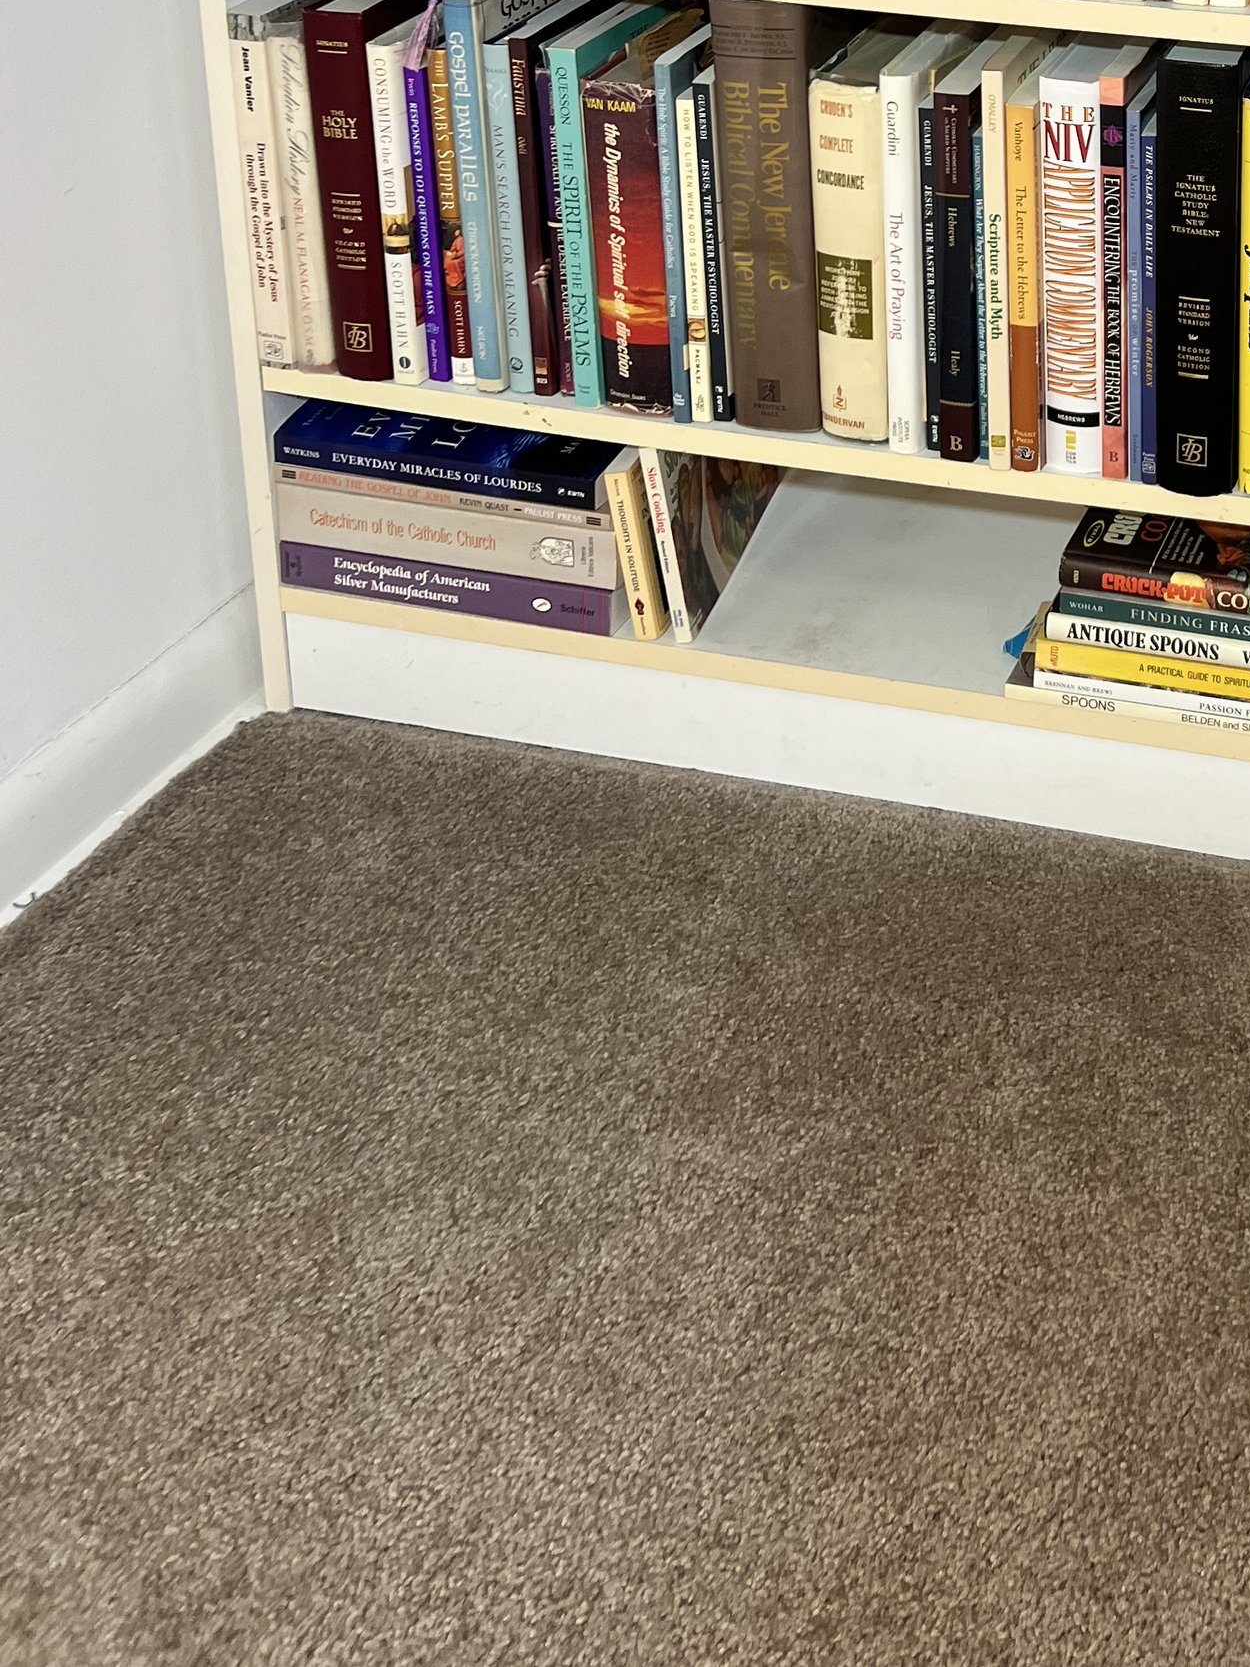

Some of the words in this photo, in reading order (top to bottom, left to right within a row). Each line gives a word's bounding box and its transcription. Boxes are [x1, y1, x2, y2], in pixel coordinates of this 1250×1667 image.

[555, 66, 571, 126] QUESSON
[586, 98, 604, 111] VAN
[607, 99, 636, 113] KAAM
[1178, 96, 1214, 105] IGNATIUS
[431, 83, 454, 142] LAMB'S
[757, 81, 789, 134] The
[820, 99, 853, 118] CRUDEN'S
[1042, 102, 1095, 122] THE
[321, 115, 357, 129] HOLY
[723, 80, 754, 177] Biblical
[886, 100, 900, 156] Guardini
[323, 127, 358, 140] BIBLE
[923, 120, 933, 167] GUARENDI
[1043, 119, 1096, 163] NIV
[819, 135, 854, 154] COMPLETE
[438, 150, 456, 211] SUPPER
[760, 140, 789, 200] New
[817, 169, 865, 190] CONCORDANCE
[1174, 191, 1218, 201] CATHOLIC
[1176, 182, 1216, 192] IGNATIUS
[1182, 200, 1210, 209] STUDY
[1171, 226, 1221, 237] TESTAMENT
[390, 262, 405, 309] SCOTT
[707, 258, 720, 335] PSYCHOLOGIST
[395, 312, 408, 348] HAHN
[571, 293, 591, 367] PSALMS
[283, 446, 320, 459] WATKINS
[332, 452, 398, 472] EVERYDAY
[400, 462, 462, 481] MIRACLES
[464, 472, 481, 483] OF
[484, 475, 542, 493] LOURDES
[647, 467, 658, 489] Slow
[459, 498, 483, 508] KEVIN
[485, 501, 510, 512] QUAST
[524, 506, 555, 520] PAULIST
[557, 511, 584, 524] PRESS
[651, 493, 666, 534] Cooking
[310, 508, 368, 532] Catechism
[371, 520, 384, 534] of
[387, 520, 405, 537] the
[408, 523, 453, 545] Catholic
[456, 530, 496, 551] Church
[333, 557, 412, 580] Encyclopedia
[415, 571, 430, 586] of
[430, 575, 491, 592] American
[334, 574, 368, 589] Silver
[371, 581, 459, 604] Manufacturers
[560, 604, 596, 617] Schiffer
[1069, 601, 1104, 613] WOHAR
[1131, 608, 1203, 629] FINDING
[1067, 623, 1146, 649] ANTIQUE
[1149, 634, 1220, 661] SPOONS
[1051, 646, 1059, 667] MUTO
[1061, 694, 1116, 712] SPOONS
[1199, 702, 1243, 716] PASSION
